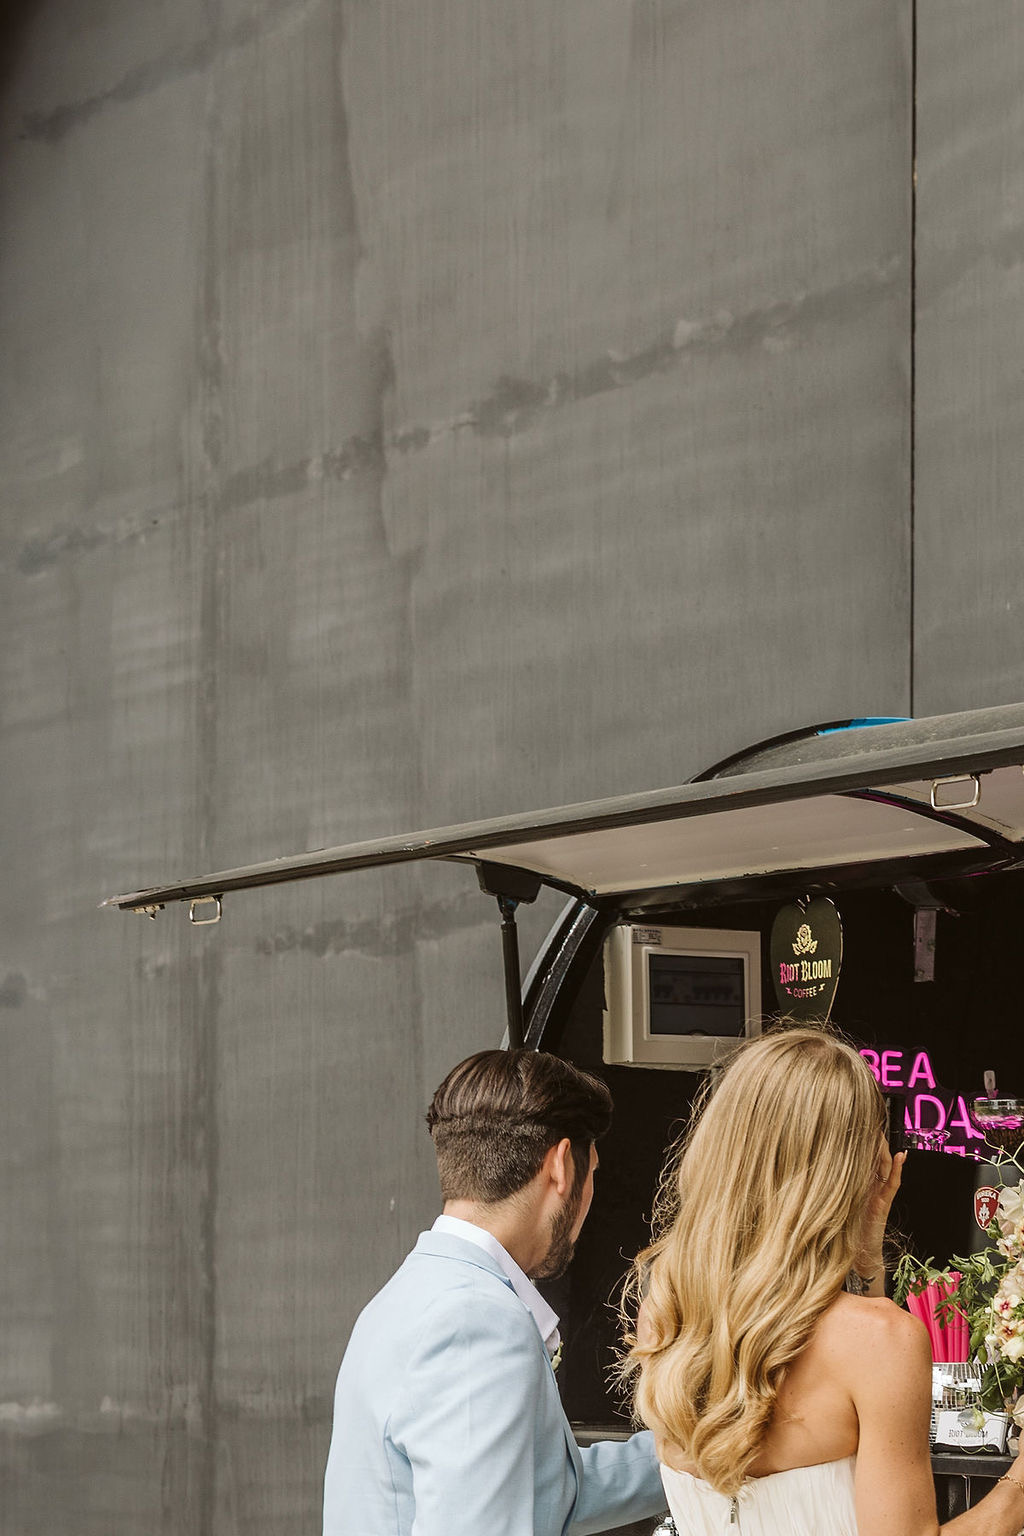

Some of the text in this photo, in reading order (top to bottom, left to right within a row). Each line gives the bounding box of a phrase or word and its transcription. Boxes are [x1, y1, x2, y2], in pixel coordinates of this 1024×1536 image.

[780, 959, 832, 984] RIOT BLOOM
[793, 986, 818, 998] COFFEE
[907, 1051, 937, 1090] A
